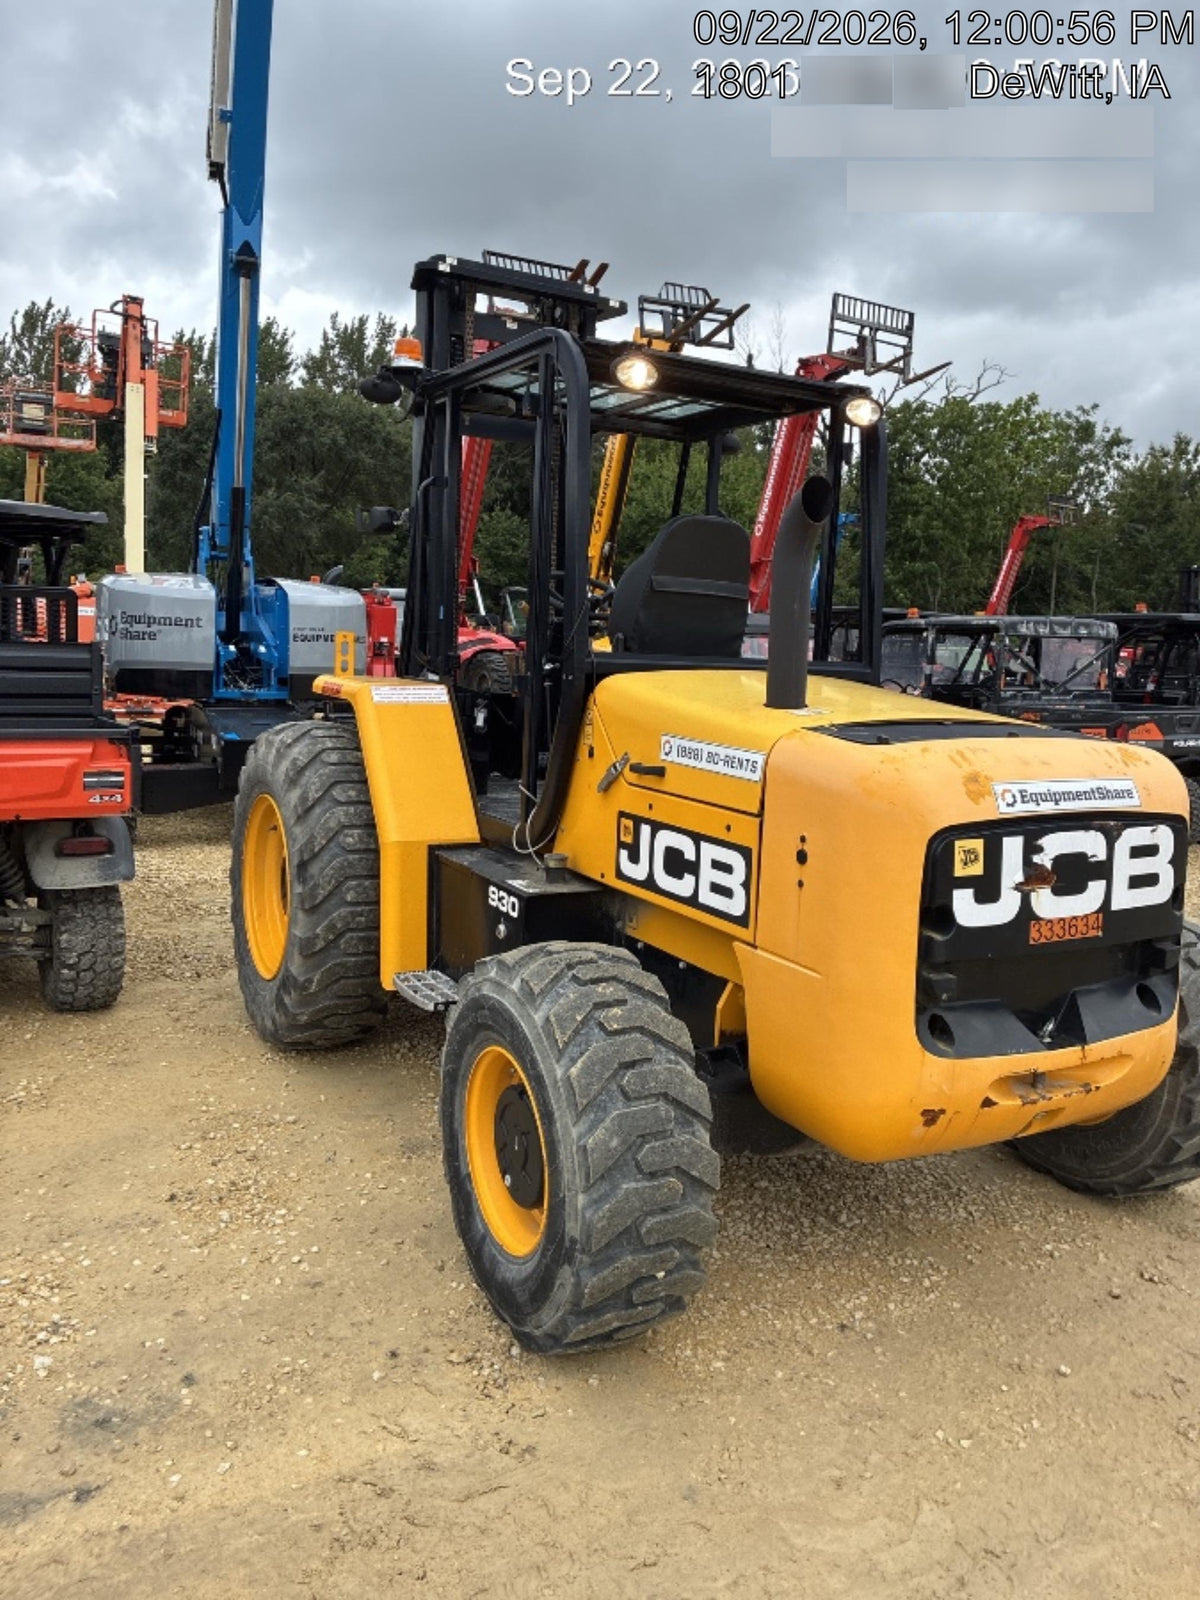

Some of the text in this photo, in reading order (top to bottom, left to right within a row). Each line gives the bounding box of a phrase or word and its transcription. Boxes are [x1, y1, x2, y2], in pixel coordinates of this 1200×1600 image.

[120, 610, 204, 629] Equipment
[120, 627, 158, 641] Share
[1017, 784, 1135, 807] EquipmentShare
[619, 822, 747, 917] JCB
[952, 823, 1175, 927] JCB
[488, 885, 520, 918] 930
[1030, 914, 1103, 943] 333634
